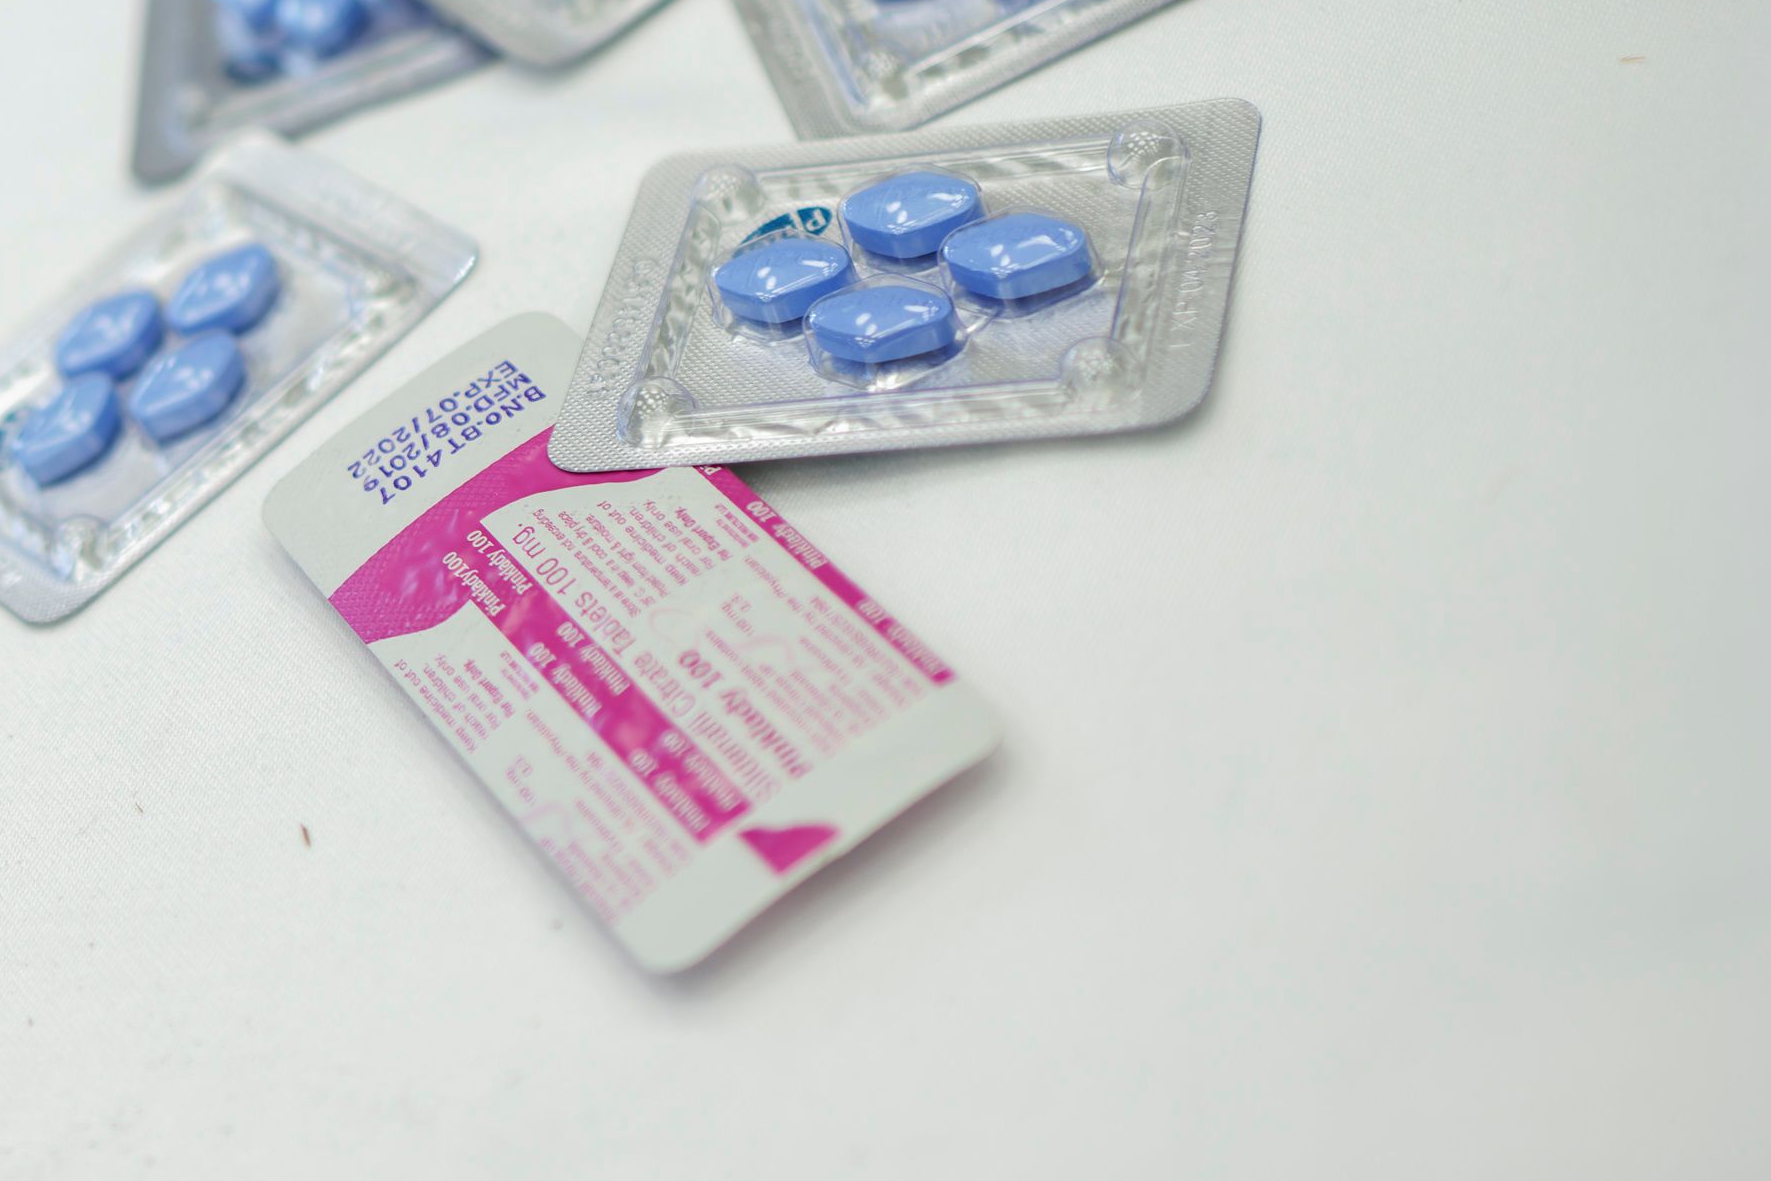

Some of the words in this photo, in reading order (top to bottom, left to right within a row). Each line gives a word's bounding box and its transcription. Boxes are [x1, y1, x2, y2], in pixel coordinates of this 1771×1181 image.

[348, 361, 518, 478] EXP.07/2022
[364, 368, 531, 491] MFD.08/2019
[597, 501, 611, 510] of
[608, 510, 626, 524] out
[644, 499, 665, 521] only.
[675, 507, 696, 527] Only.
[747, 501, 777, 522] 100
[532, 509, 565, 540] exceeding
[558, 511, 580, 528] place
[629, 506, 665, 542] children.
[664, 521, 683, 536] use
[467, 531, 493, 553] 100
[513, 524, 545, 558] mg.
[574, 526, 588, 539] dry
[692, 526, 720, 551] Export
[774, 517, 831, 568] Pinklady
[560, 539, 575, 551] not
[588, 544, 607, 559] cool
[625, 526, 665, 564] medicine
[661, 542, 676, 552] of
[679, 537, 700, 555] oral
[717, 549, 730, 561] For
[487, 550, 532, 594] Pinklady
[574, 551, 611, 588] temperature
[665, 564, 686, 585] Keep
[676, 554, 701, 576] reach
[699, 557, 714, 570] For
[536, 558, 576, 594] 100
[558, 622, 584, 647] 100
[575, 592, 635, 657] Tablets
[394, 659, 407, 670] of
[528, 643, 555, 667] 100
[581, 639, 629, 694] Pinklady
[404, 670, 420, 686] out
[679, 650, 721, 688] 100
[453, 676, 468, 691] use
[553, 665, 600, 719] Pinklady
[634, 652, 695, 717] Citrate
[419, 686, 455, 726] medicine
[721, 691, 808, 777] Pinklady
